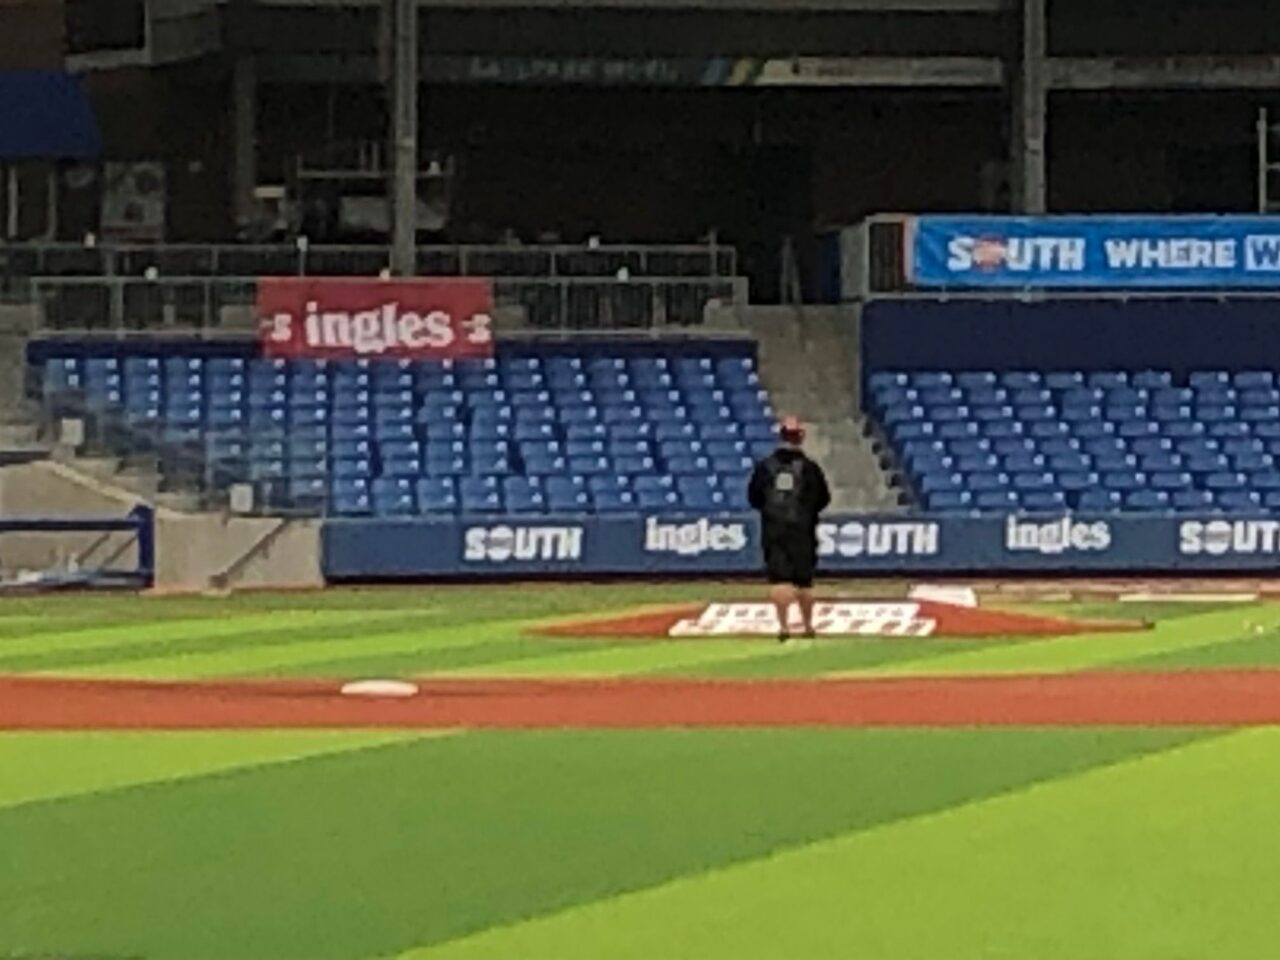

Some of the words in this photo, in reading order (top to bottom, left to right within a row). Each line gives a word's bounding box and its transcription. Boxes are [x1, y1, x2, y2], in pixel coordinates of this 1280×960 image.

[947, 234, 1086, 272] SOUTH
[1105, 239, 1237, 269] WHERE
[305, 301, 453, 354] ingles
[464, 526, 582, 561] SOUTH
[645, 517, 748, 555] ingles
[1006, 515, 1111, 553] ingles
